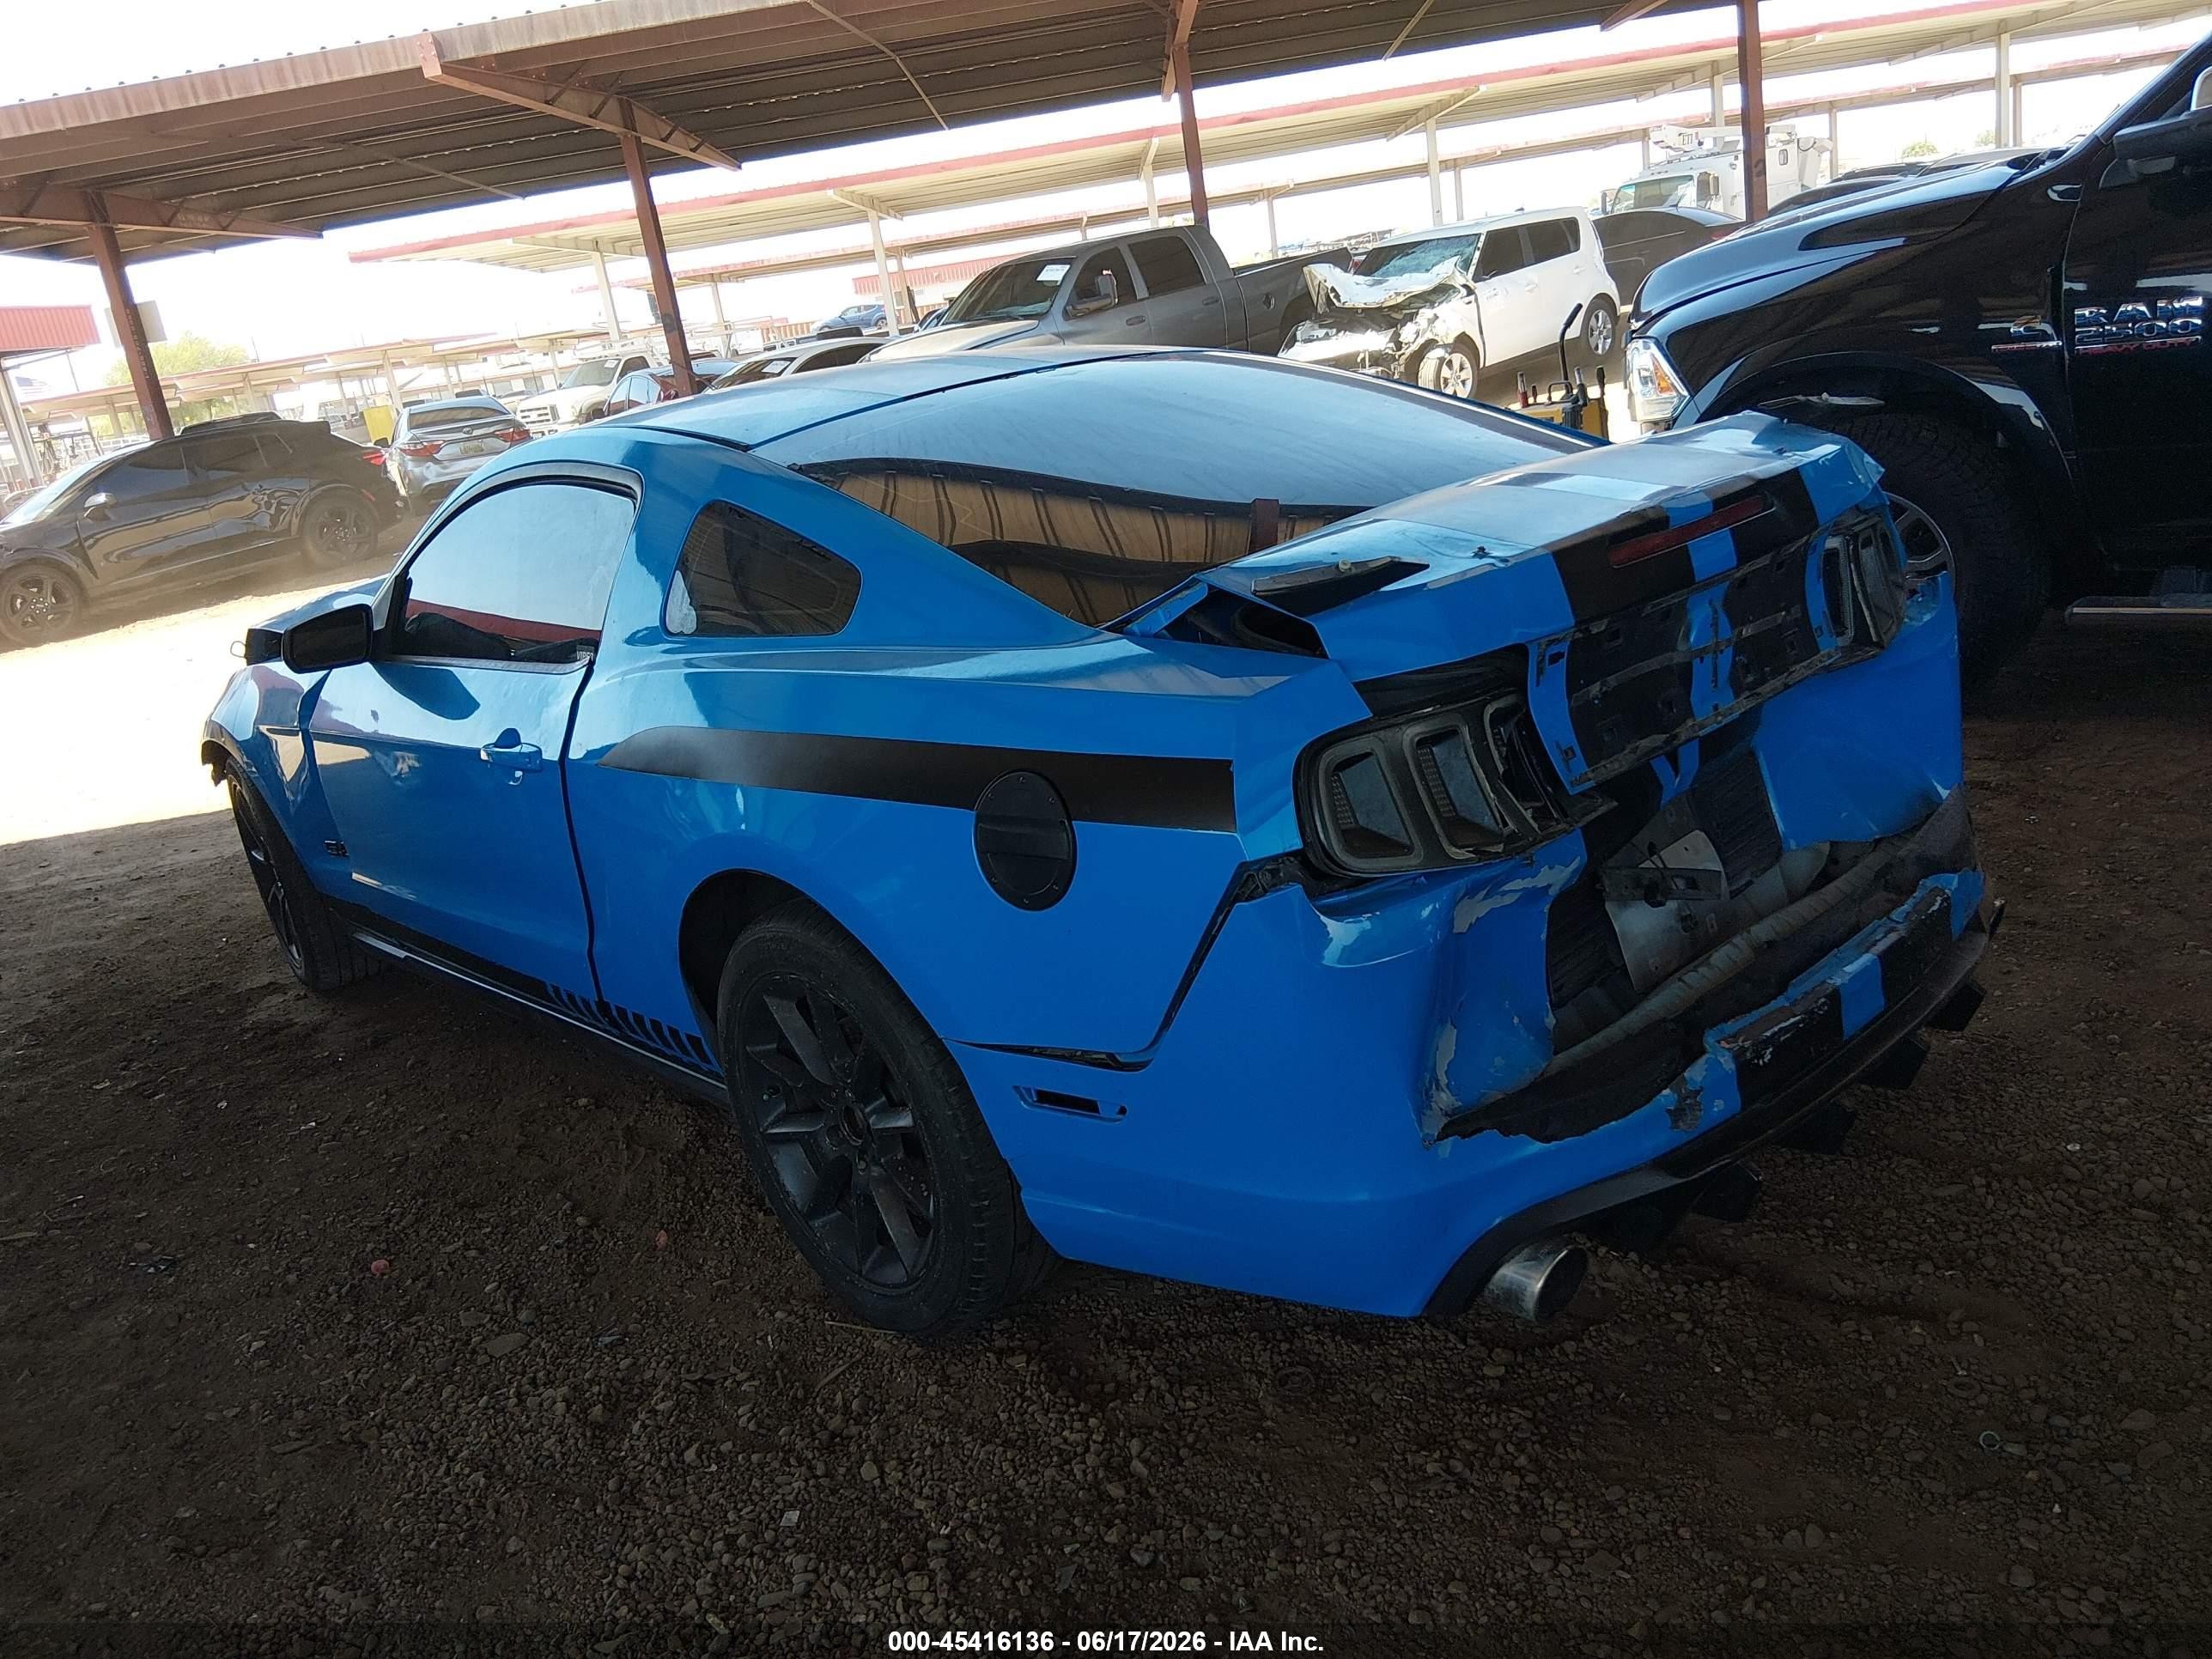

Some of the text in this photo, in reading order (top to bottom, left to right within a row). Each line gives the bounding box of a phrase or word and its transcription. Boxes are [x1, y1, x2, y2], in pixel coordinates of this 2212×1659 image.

[2074, 296, 2203, 325] RAM
[2074, 317, 2203, 345] 2500
[2142, 337, 2197, 350] DUTY
